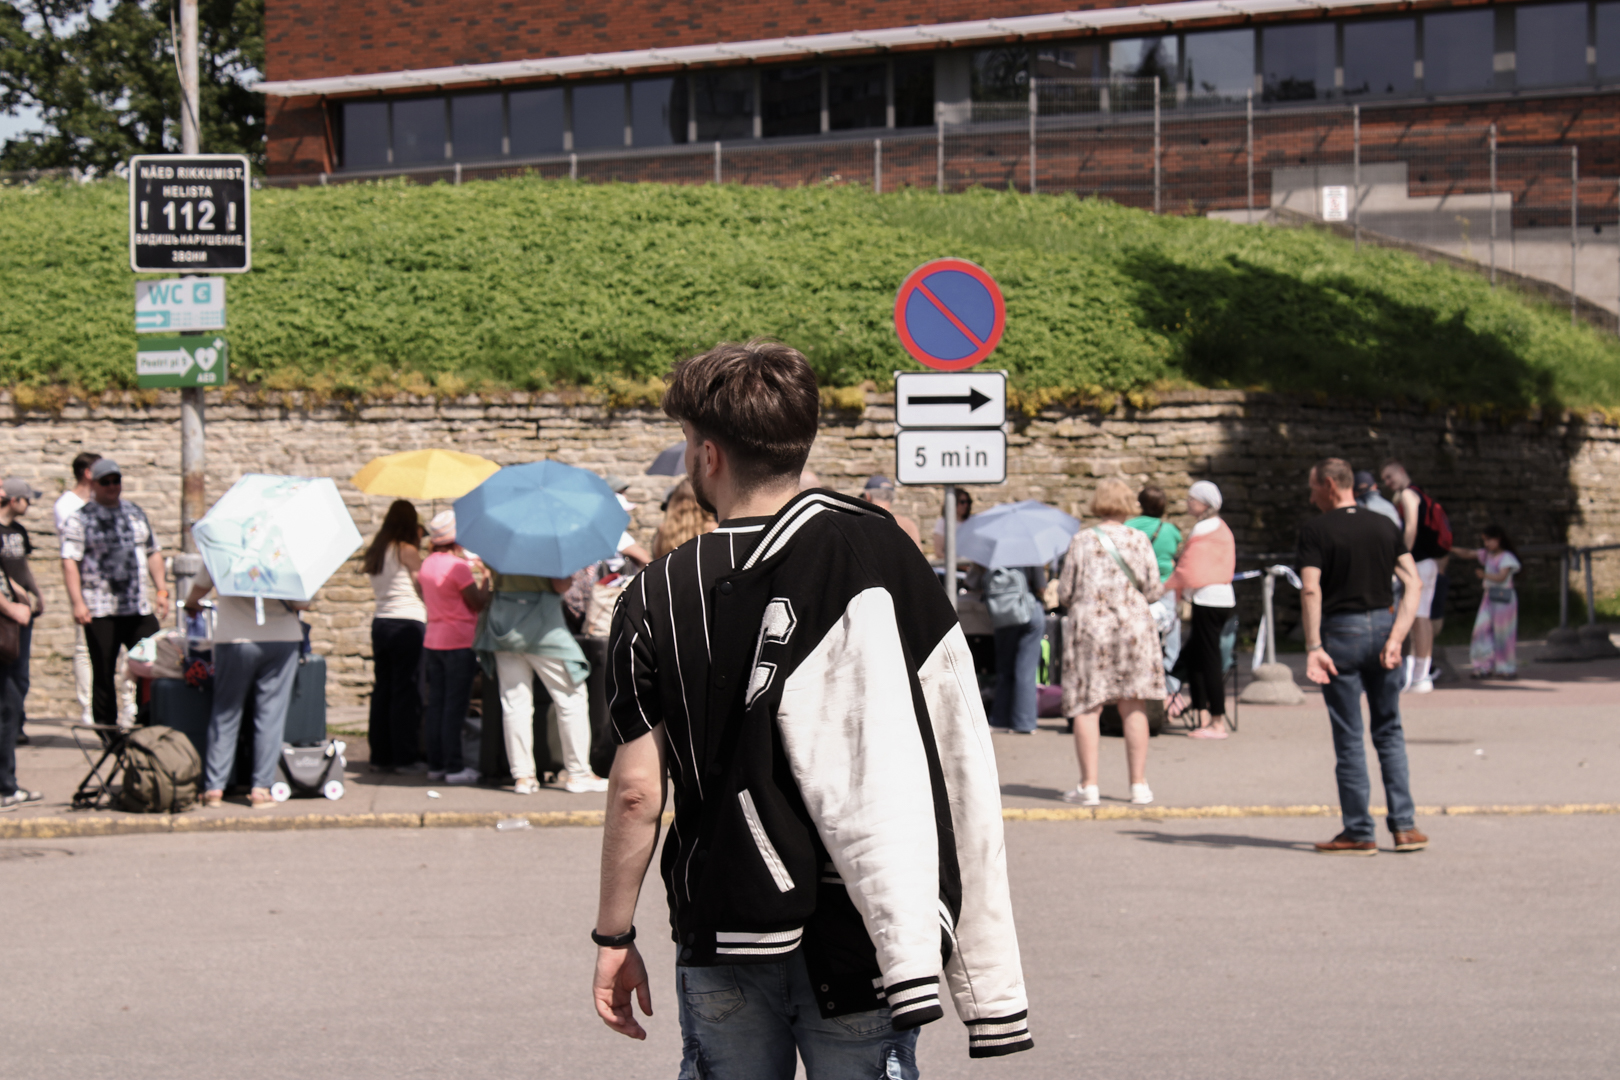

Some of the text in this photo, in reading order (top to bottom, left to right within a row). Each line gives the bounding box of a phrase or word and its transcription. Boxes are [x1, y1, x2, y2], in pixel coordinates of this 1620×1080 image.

[141, 165, 174, 179] NÄED
[162, 185, 213, 198] HELISTA
[162, 200, 216, 230] 112
[136, 233, 180, 246] ВИДИШЬ
[172, 250, 208, 262] ЗВОНИ
[148, 284, 183, 305] WC
[196, 372, 217, 383] AED
[915, 445, 987, 468] 5 min
